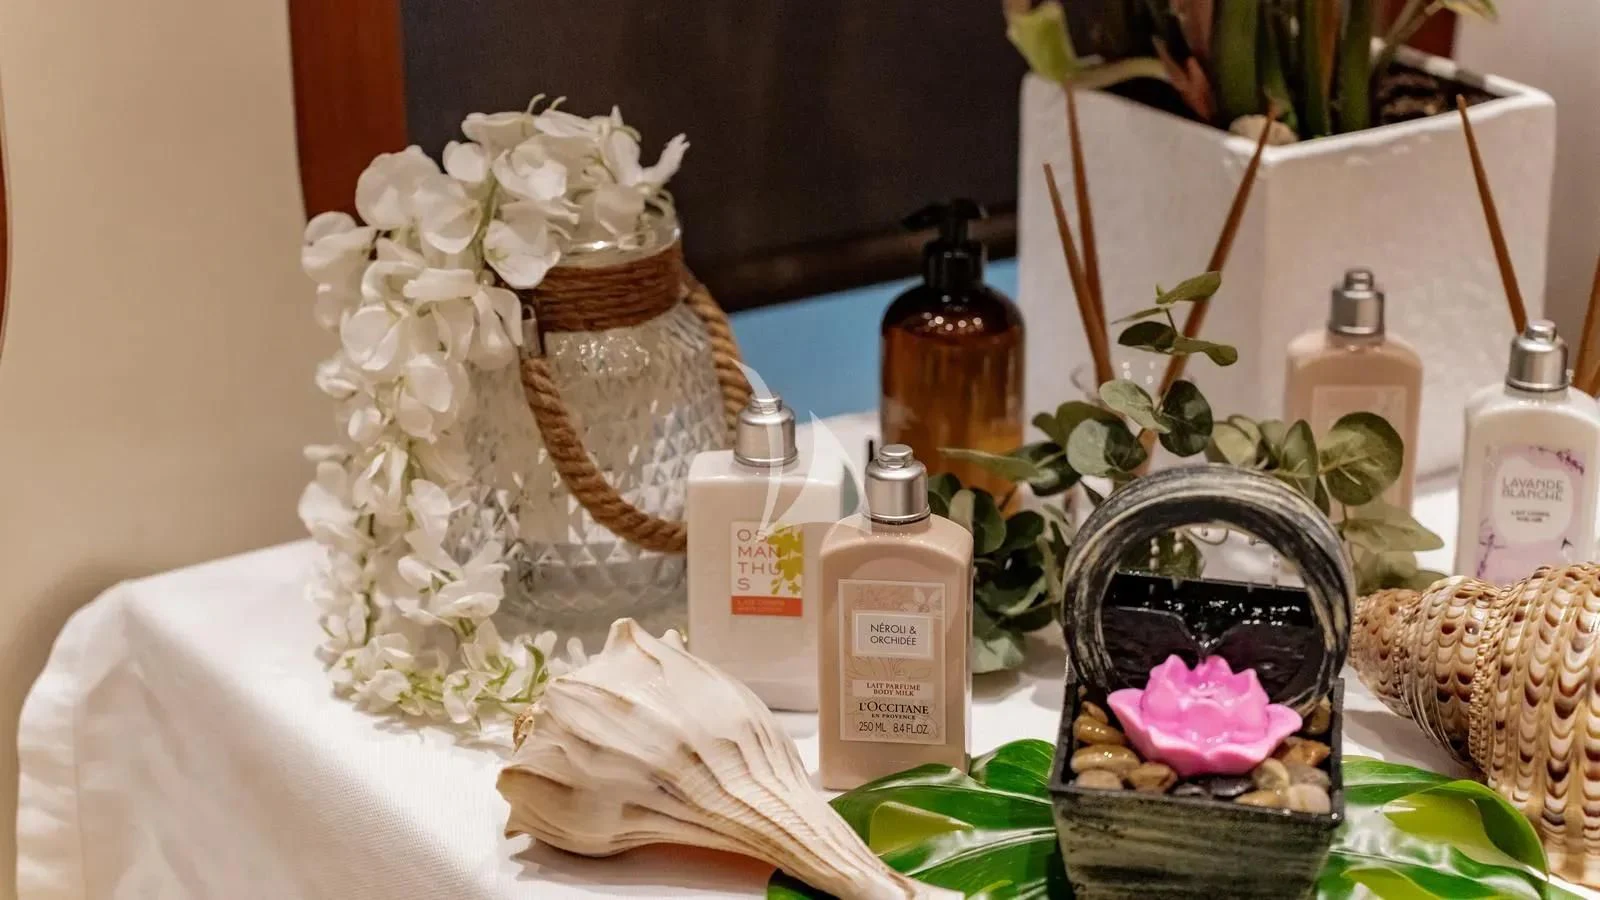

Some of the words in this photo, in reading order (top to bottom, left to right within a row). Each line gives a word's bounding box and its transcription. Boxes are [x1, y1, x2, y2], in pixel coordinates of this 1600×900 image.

[1502, 476, 1564, 489] LAVANDE
[1502, 487, 1563, 501] BLANCHE
[737, 546, 782, 558] MAN
[737, 562, 781, 575] THU
[737, 578, 751, 591] S
[870, 622, 906, 634] NÉROLI
[909, 625, 917, 635] &
[870, 635, 917, 646] ORCHIDÉE
[859, 721, 874, 732] 250
[875, 722, 887, 733] ML
